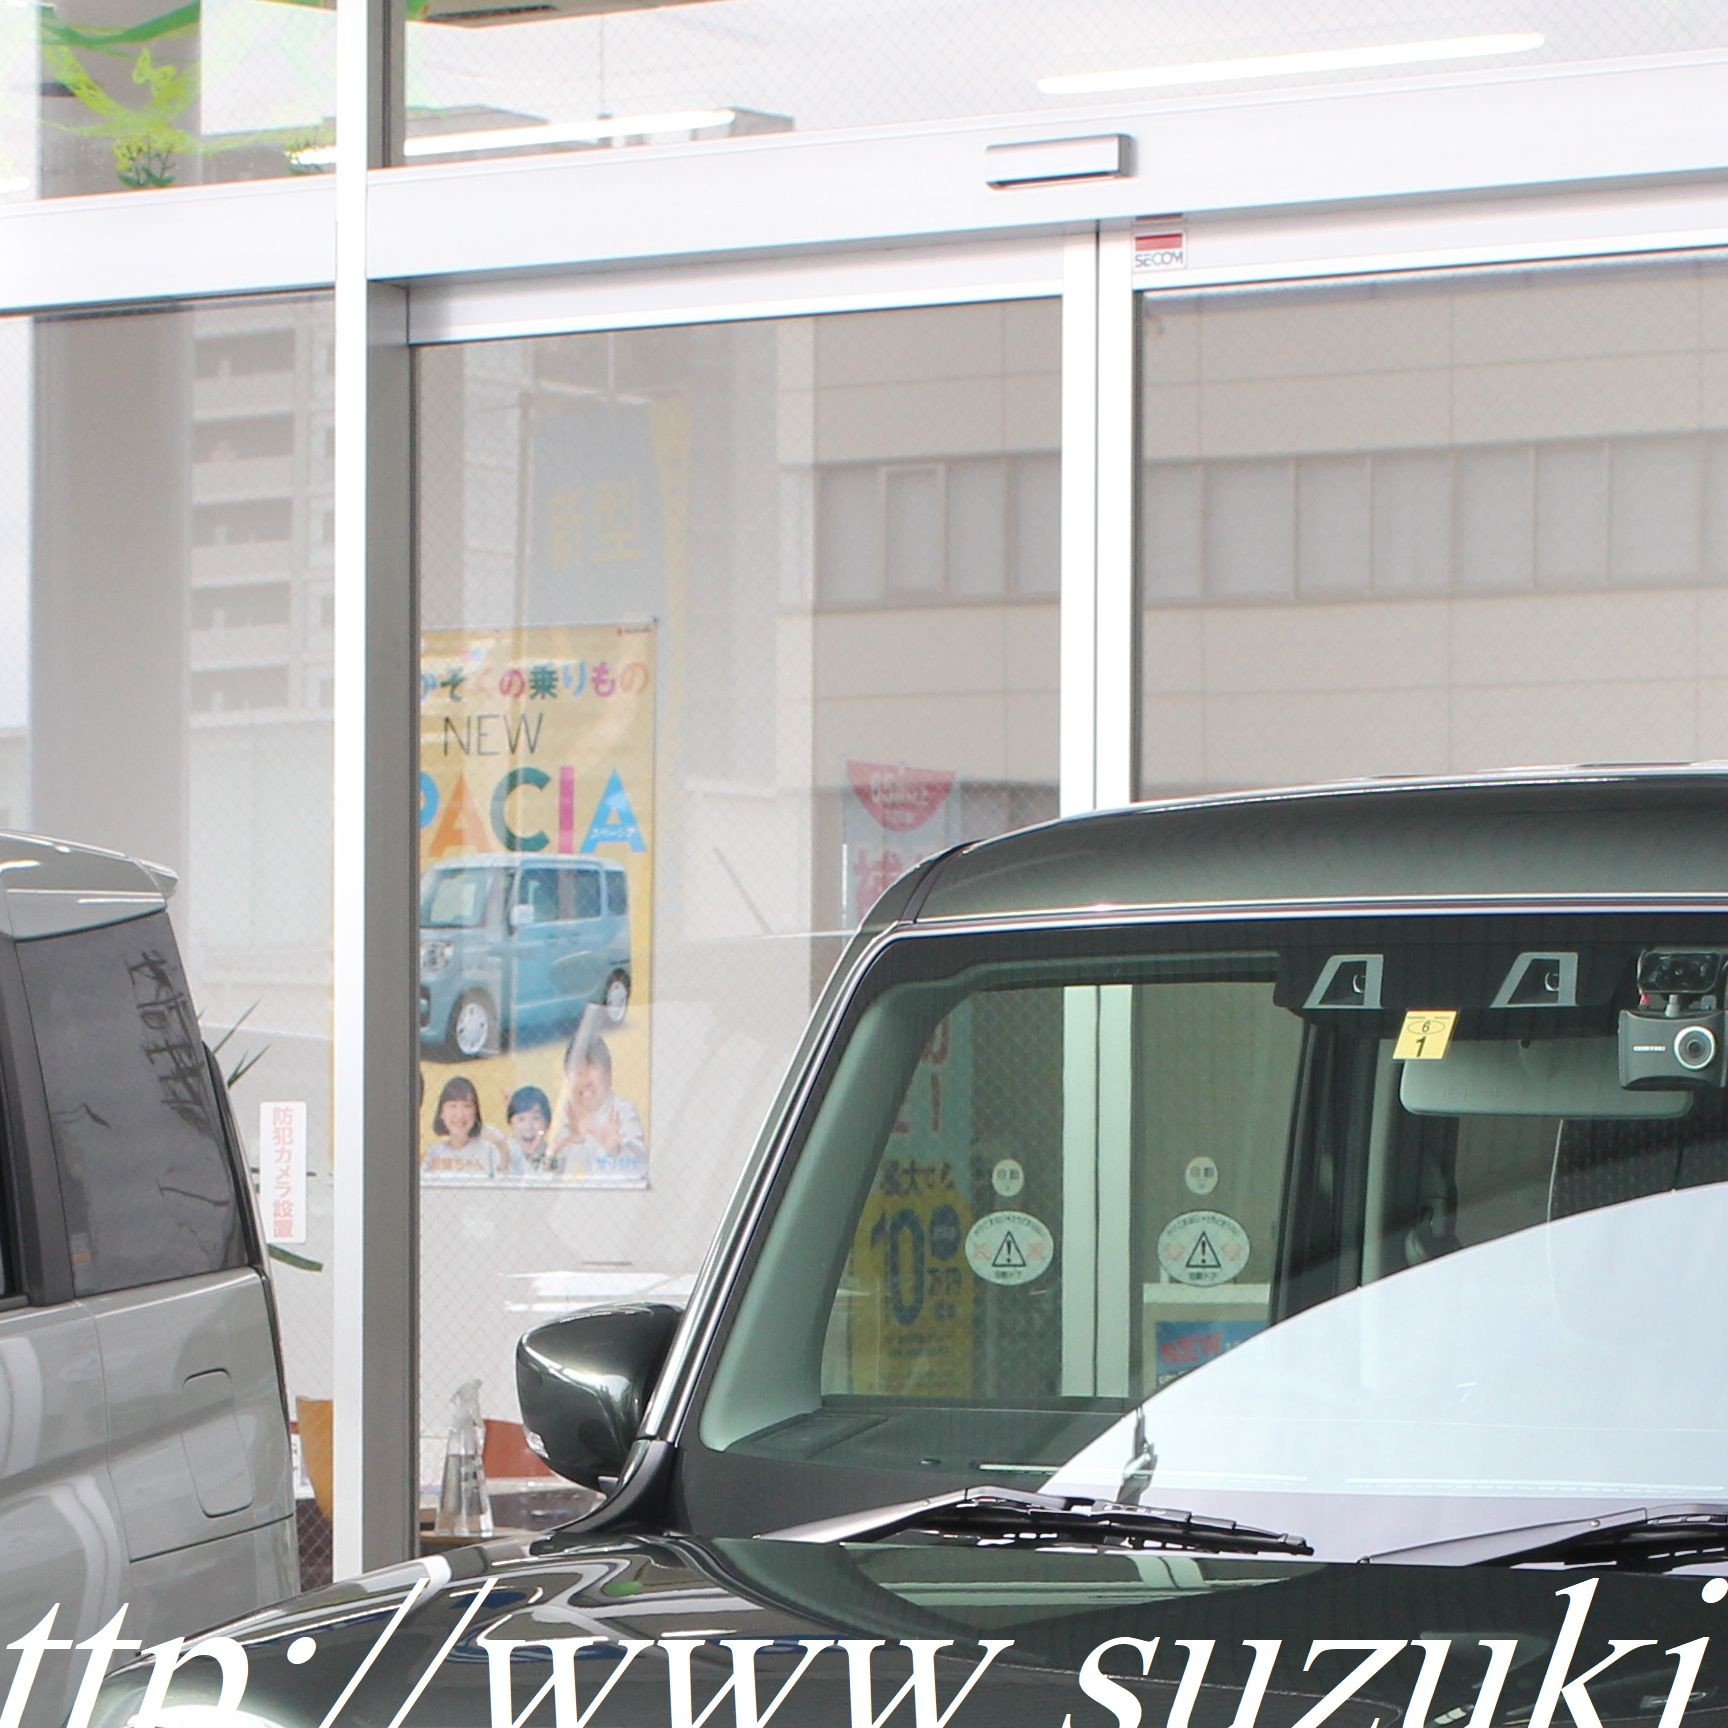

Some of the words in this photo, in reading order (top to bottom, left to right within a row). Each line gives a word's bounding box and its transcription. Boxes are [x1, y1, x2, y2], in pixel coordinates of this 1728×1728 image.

[1135, 250, 1184, 268] SECOM
[443, 713, 543, 756] NEW
[1421, 1020, 1432, 1034] 6
[1415, 1036, 1427, 1058] 1
[272, 1107, 295, 1239] 防犯カメラ設置
